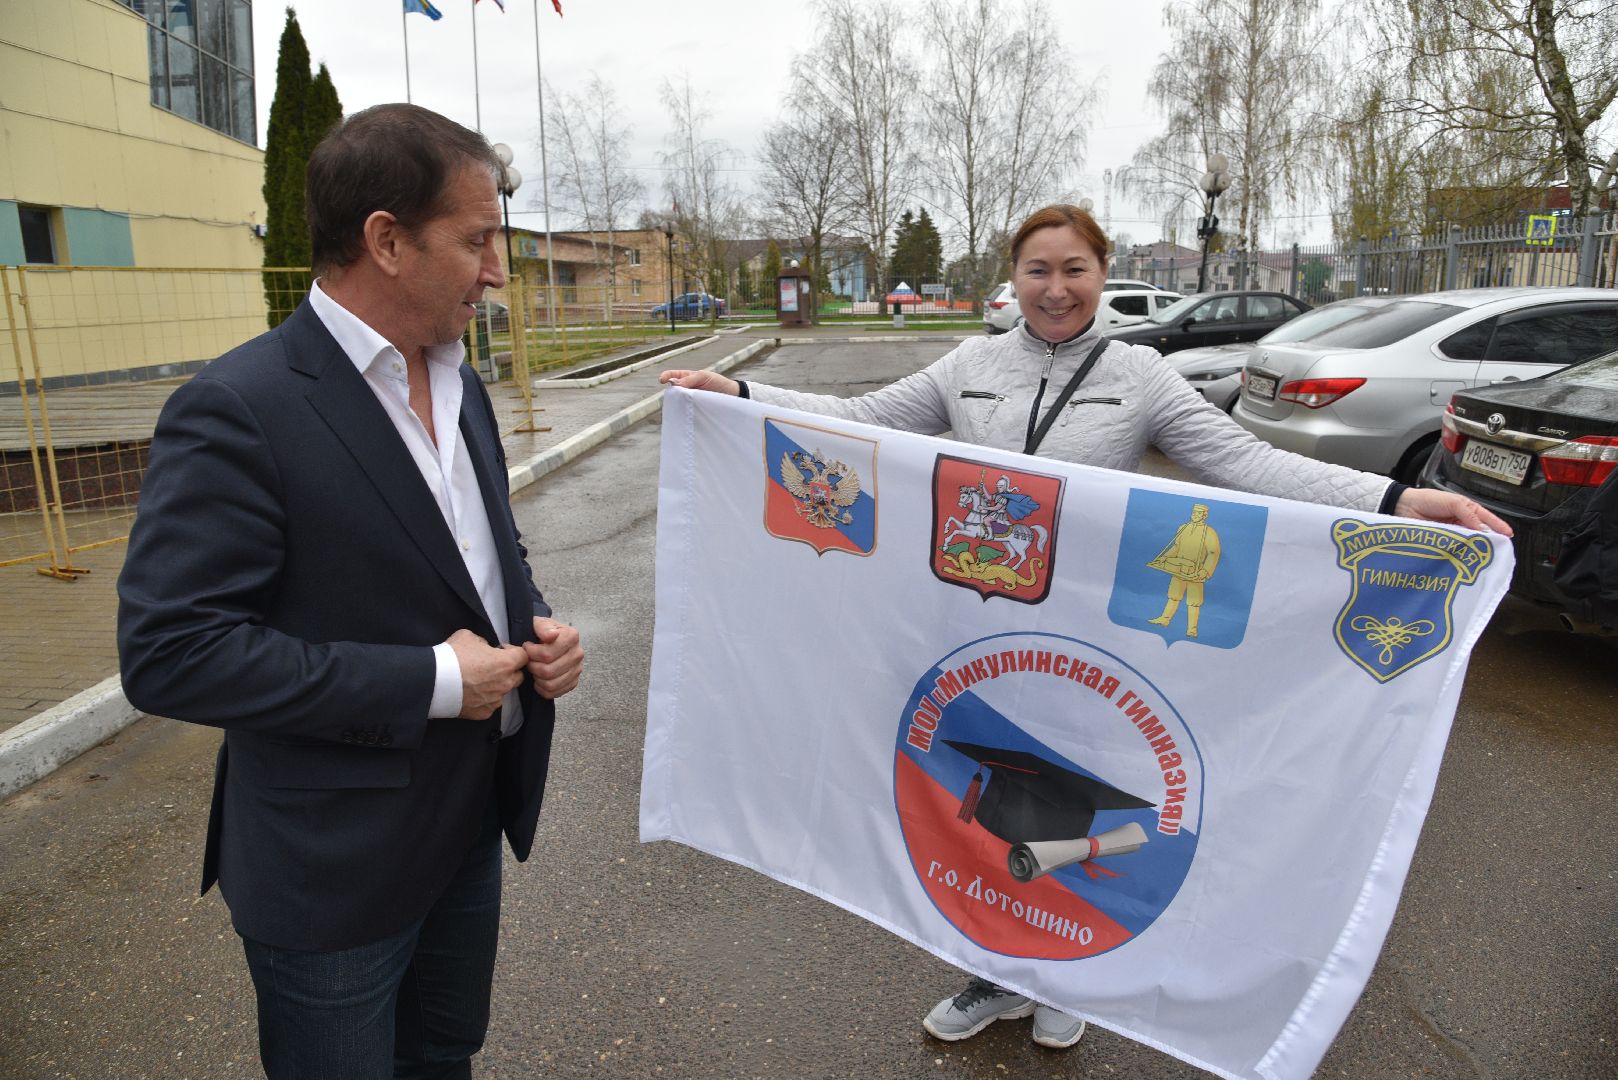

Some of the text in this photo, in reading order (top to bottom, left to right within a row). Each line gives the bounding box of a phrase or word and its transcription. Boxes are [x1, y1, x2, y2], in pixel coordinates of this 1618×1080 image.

[1345, 528, 1480, 567] МИКУЛИНСКАЯ
[1361, 568, 1450, 592] ГИМНАЗИЯ
[907, 695, 942, 752] МОУ
